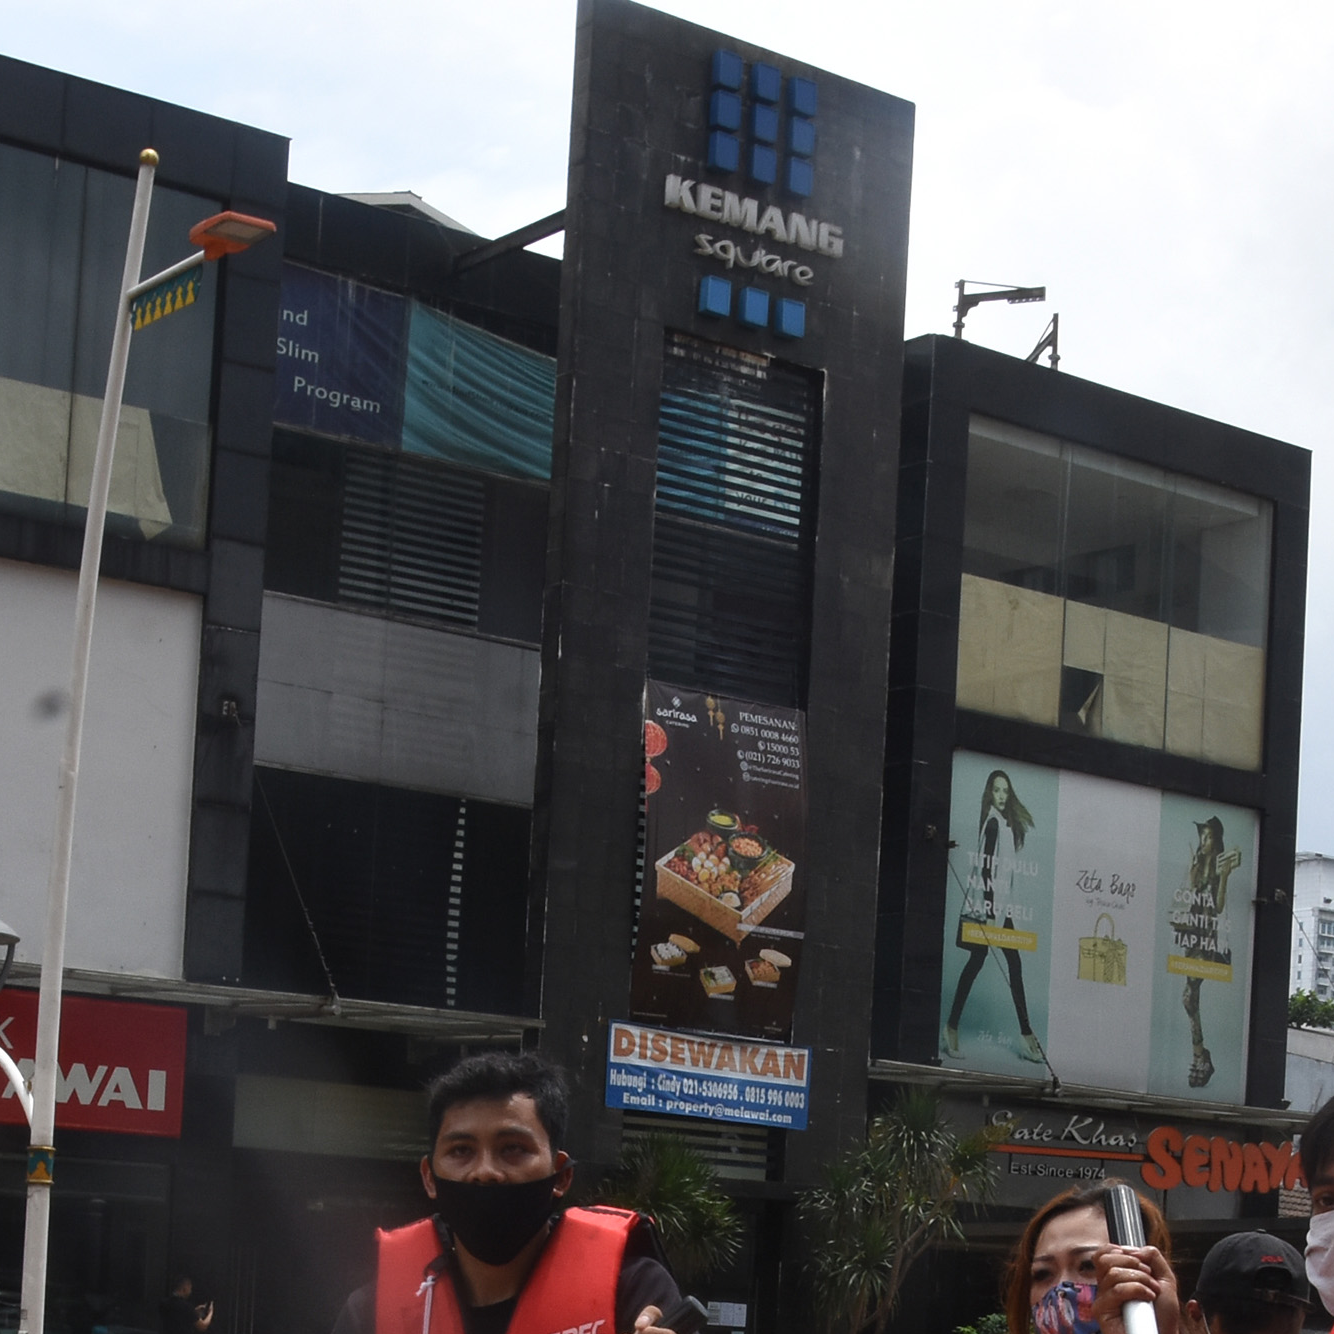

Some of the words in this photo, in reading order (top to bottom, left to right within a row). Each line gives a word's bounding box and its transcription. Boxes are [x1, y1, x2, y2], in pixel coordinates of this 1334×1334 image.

[664, 173, 844, 259] KEMANG
[693, 233, 814, 286] square
[283, 308, 308, 326] nd
[276, 337, 319, 363] Slim
[293, 376, 381, 414] Program
[656, 707, 698, 723] sarirasa
[739, 711, 798, 730] PEMESANAN:
[740, 726, 759, 737] 0851
[760, 730, 779, 741] 0008
[745, 752, 766, 764] (021)
[766, 754, 781, 765] 726
[766, 742, 788, 755] 15000
[789, 745, 800, 756] 53
[1075, 870, 1103, 894] Zeta
[1109, 873, 1137, 905] Bags
[1172, 909, 1208, 930] GANTI
[1172, 931, 1198, 949] TIAP
[613, 1028, 806, 1081] DISEWAKAN
[609, 1068, 647, 1092] Hubungi
[657, 1072, 682, 1096] Cindy
[745, 1085, 766, 1104] 0815
[767, 1089, 783, 1107] 996
[784, 1091, 805, 1109] 0003
[622, 1091, 656, 1107] Email
[666, 1099, 792, 1124] property@melawai.com
[991, 1110, 1053, 1141] Sate
[1060, 1114, 1138, 1148] Khas
[1010, 1161, 1030, 1175] Est
[1036, 1163, 1074, 1178] Since
[1077, 1166, 1105, 1180] 1974
